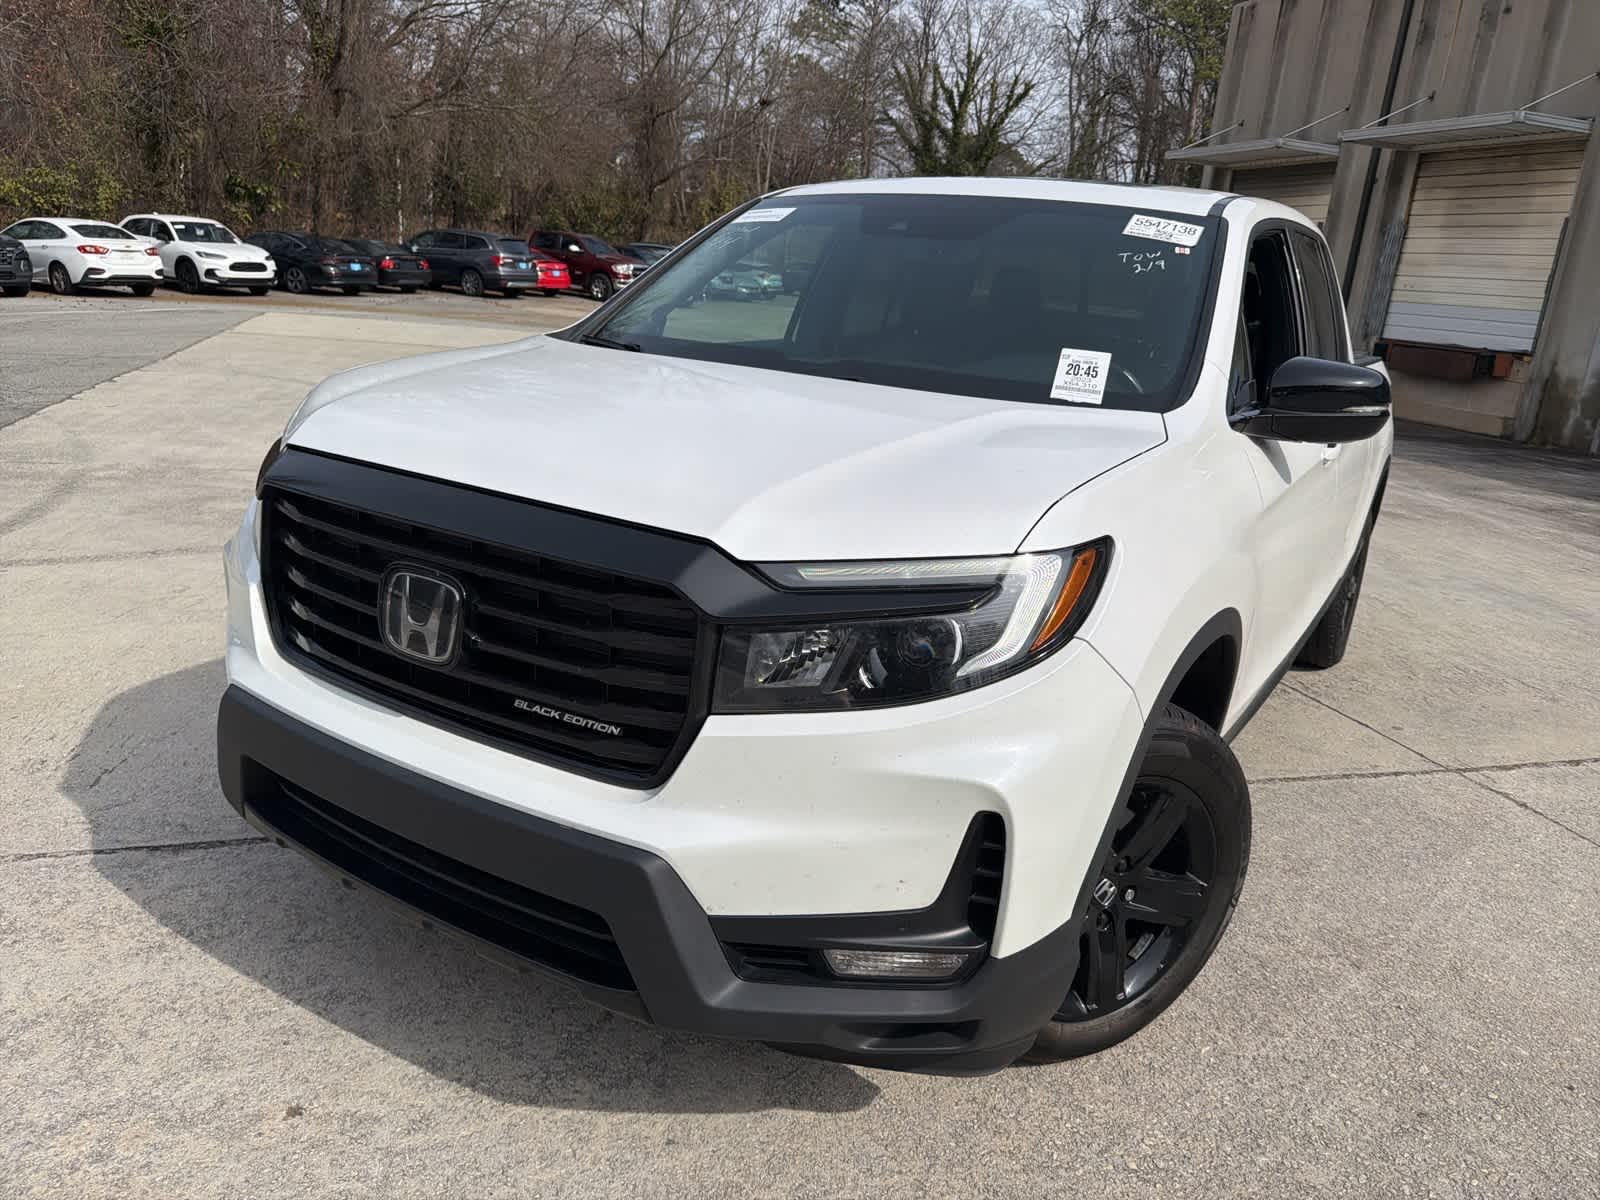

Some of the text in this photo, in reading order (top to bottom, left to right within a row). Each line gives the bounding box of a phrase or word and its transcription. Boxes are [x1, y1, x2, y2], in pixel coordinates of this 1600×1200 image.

[1134, 217, 1197, 236] 5547138
[1065, 363, 1099, 379] 20:45
[513, 699, 621, 736] BLACK EDITION
